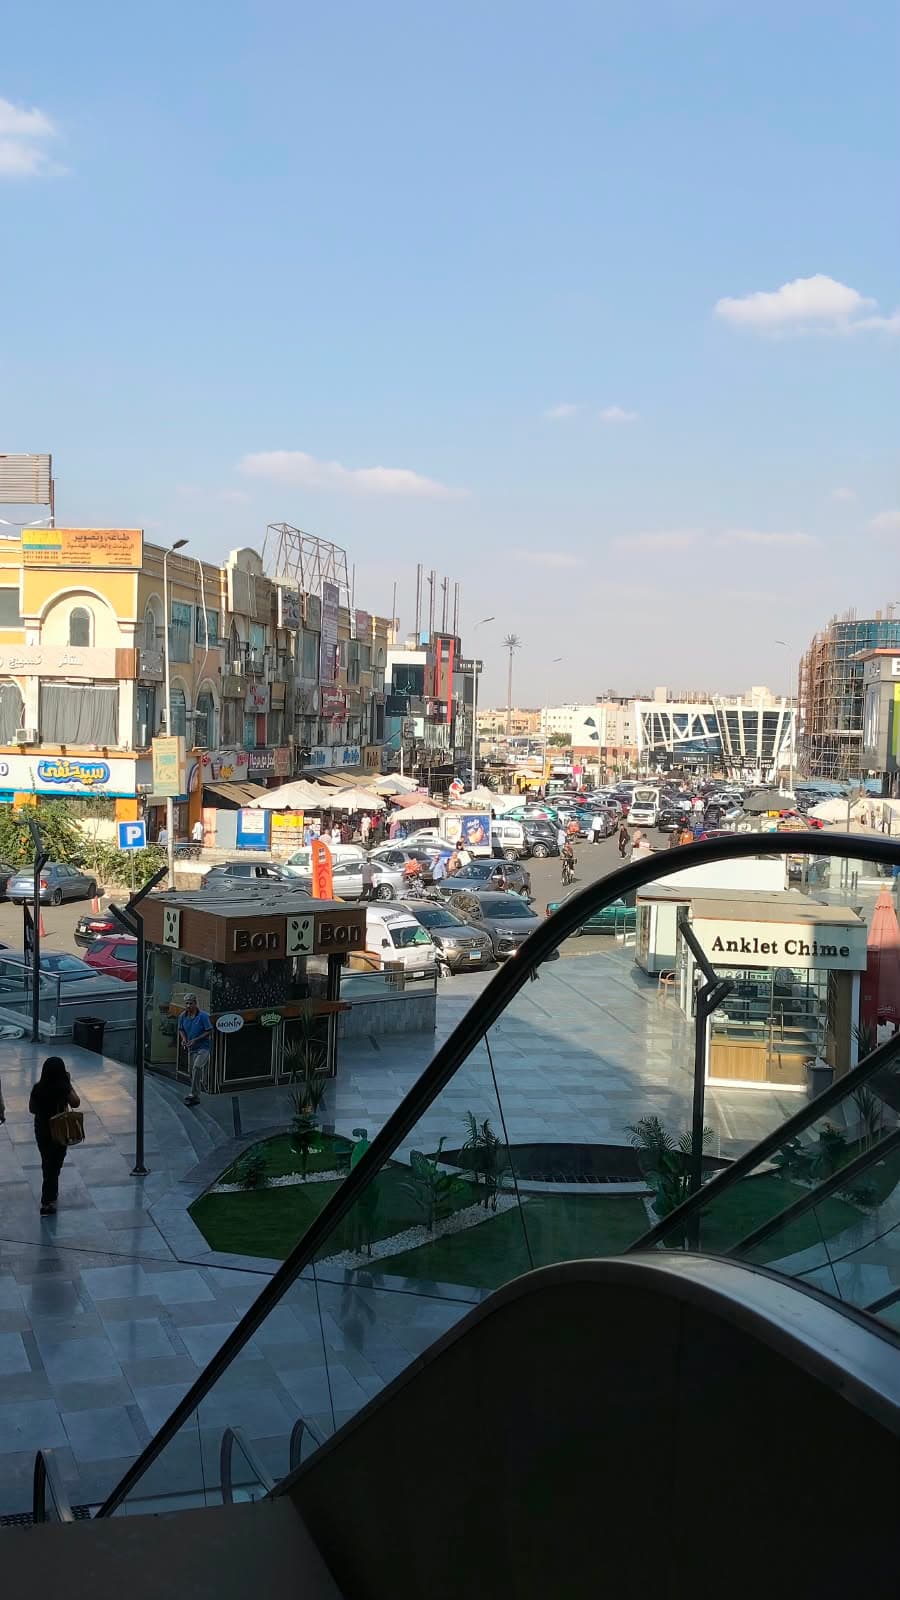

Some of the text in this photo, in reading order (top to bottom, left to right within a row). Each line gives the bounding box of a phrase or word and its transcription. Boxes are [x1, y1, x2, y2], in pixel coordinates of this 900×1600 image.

[126, 826, 142, 845] P
[233, 922, 361, 952] Bon Bon
[711, 935, 850, 957] Anklet Chime
